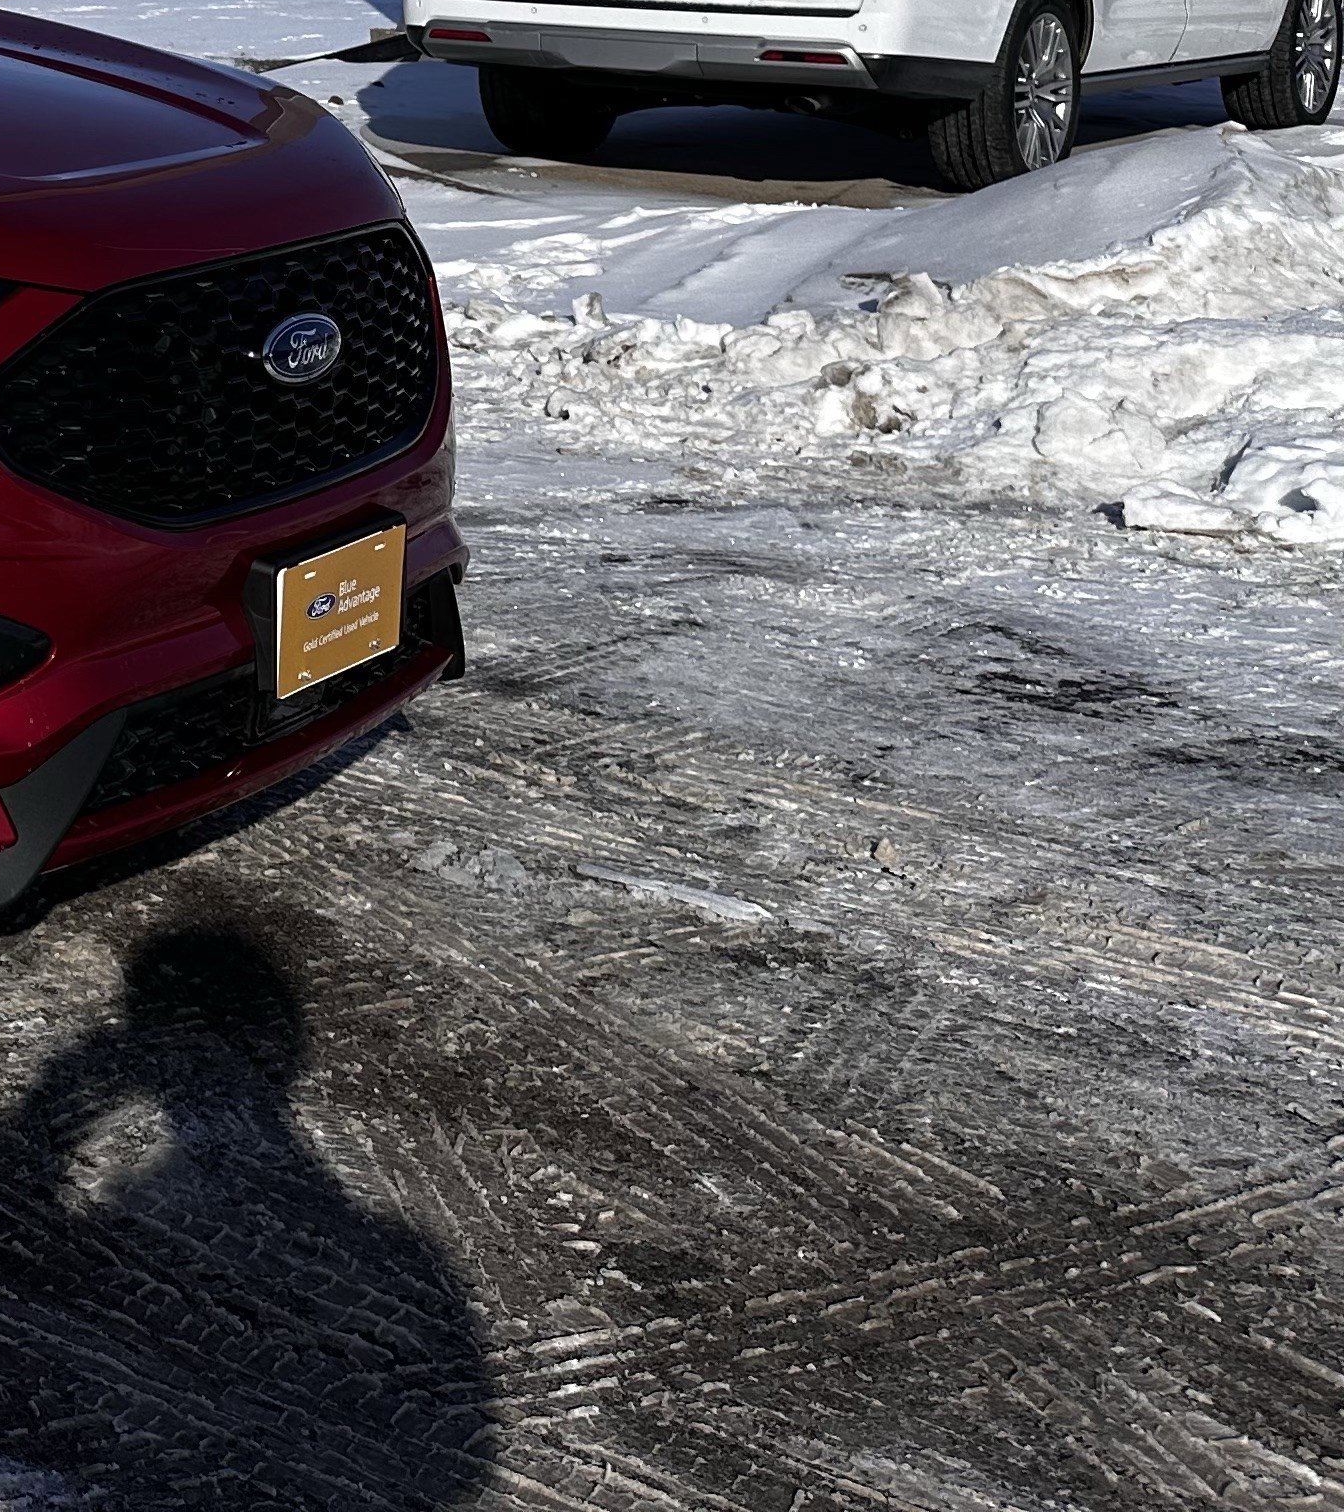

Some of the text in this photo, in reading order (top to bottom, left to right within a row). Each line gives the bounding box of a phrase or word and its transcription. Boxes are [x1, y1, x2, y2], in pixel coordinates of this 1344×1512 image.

[288, 328, 328, 369] Ford
[337, 585, 381, 614] Advantage
[339, 579, 357, 597] Blue
[312, 596, 332, 616] Ford
[303, 610, 380, 653] Gold Certified Used Vehicle
